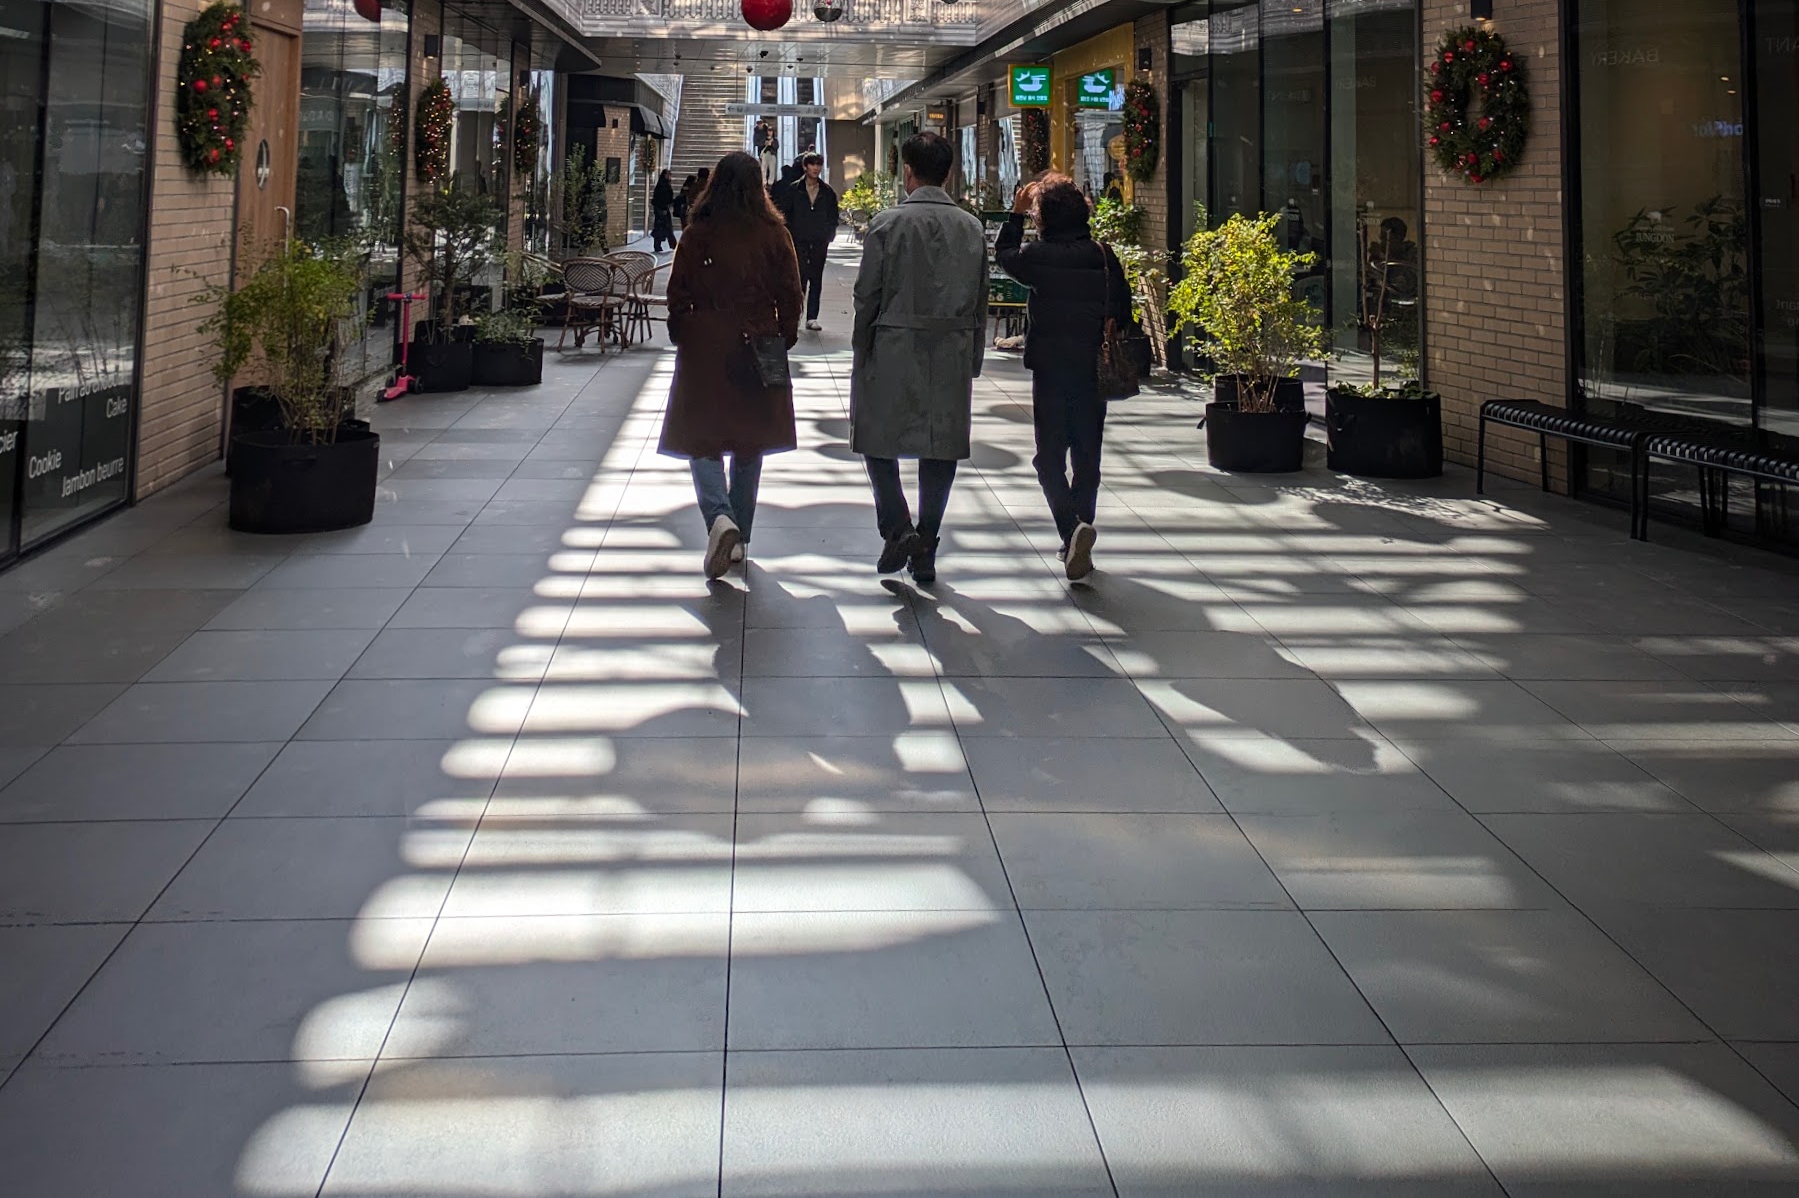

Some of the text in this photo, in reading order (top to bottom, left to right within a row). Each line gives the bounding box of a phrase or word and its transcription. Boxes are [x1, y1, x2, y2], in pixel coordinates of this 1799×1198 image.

[106, 396, 128, 419] Cake
[28, 448, 62, 480] Cookie
[61, 457, 124, 498] Jambon beurre
